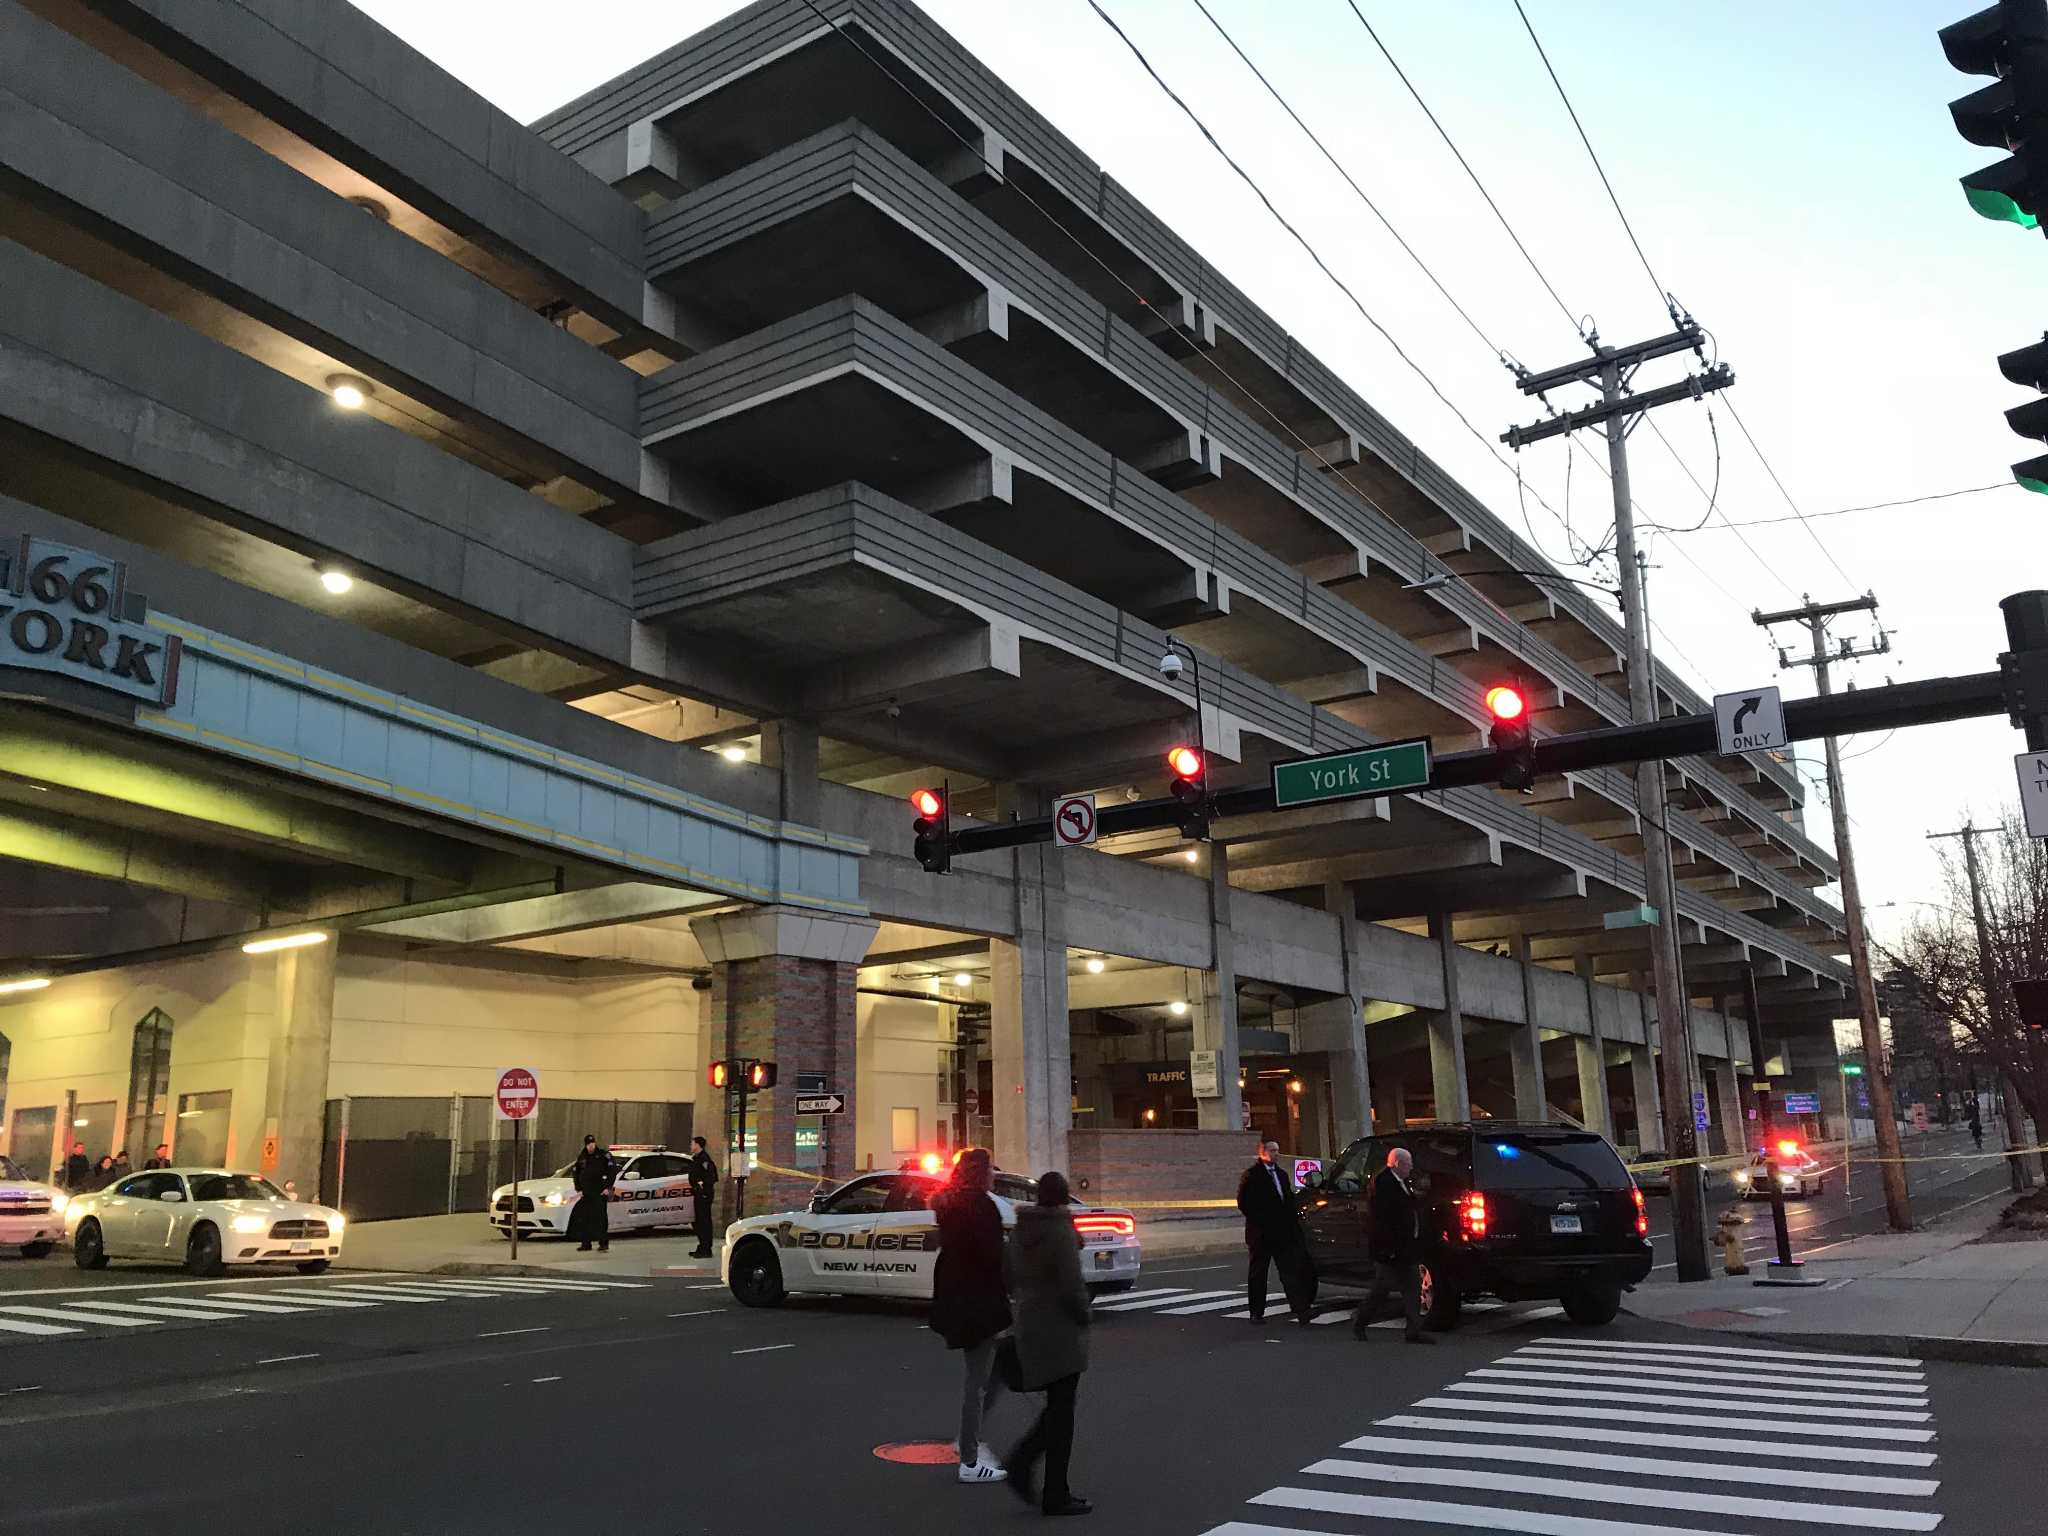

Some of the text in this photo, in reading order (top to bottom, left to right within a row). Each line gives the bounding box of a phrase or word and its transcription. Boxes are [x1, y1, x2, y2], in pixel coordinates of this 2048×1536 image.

[30, 555, 109, 614] 66
[0, 604, 161, 685] ORK
[1733, 732, 1770, 749] ONLY
[1310, 758, 1390, 790] York St
[503, 1077, 532, 1087] DO NOT
[1147, 1071, 1186, 1082] TRAFFIC
[505, 1100, 529, 1109] ENTER
[799, 1100, 829, 1110] ONE WAY
[620, 1188, 694, 1201] POLICE
[653, 1205, 684, 1213] HAVEN
[799, 1231, 926, 1250] POLICE
[823, 1262, 917, 1273] NEW HAVEN
